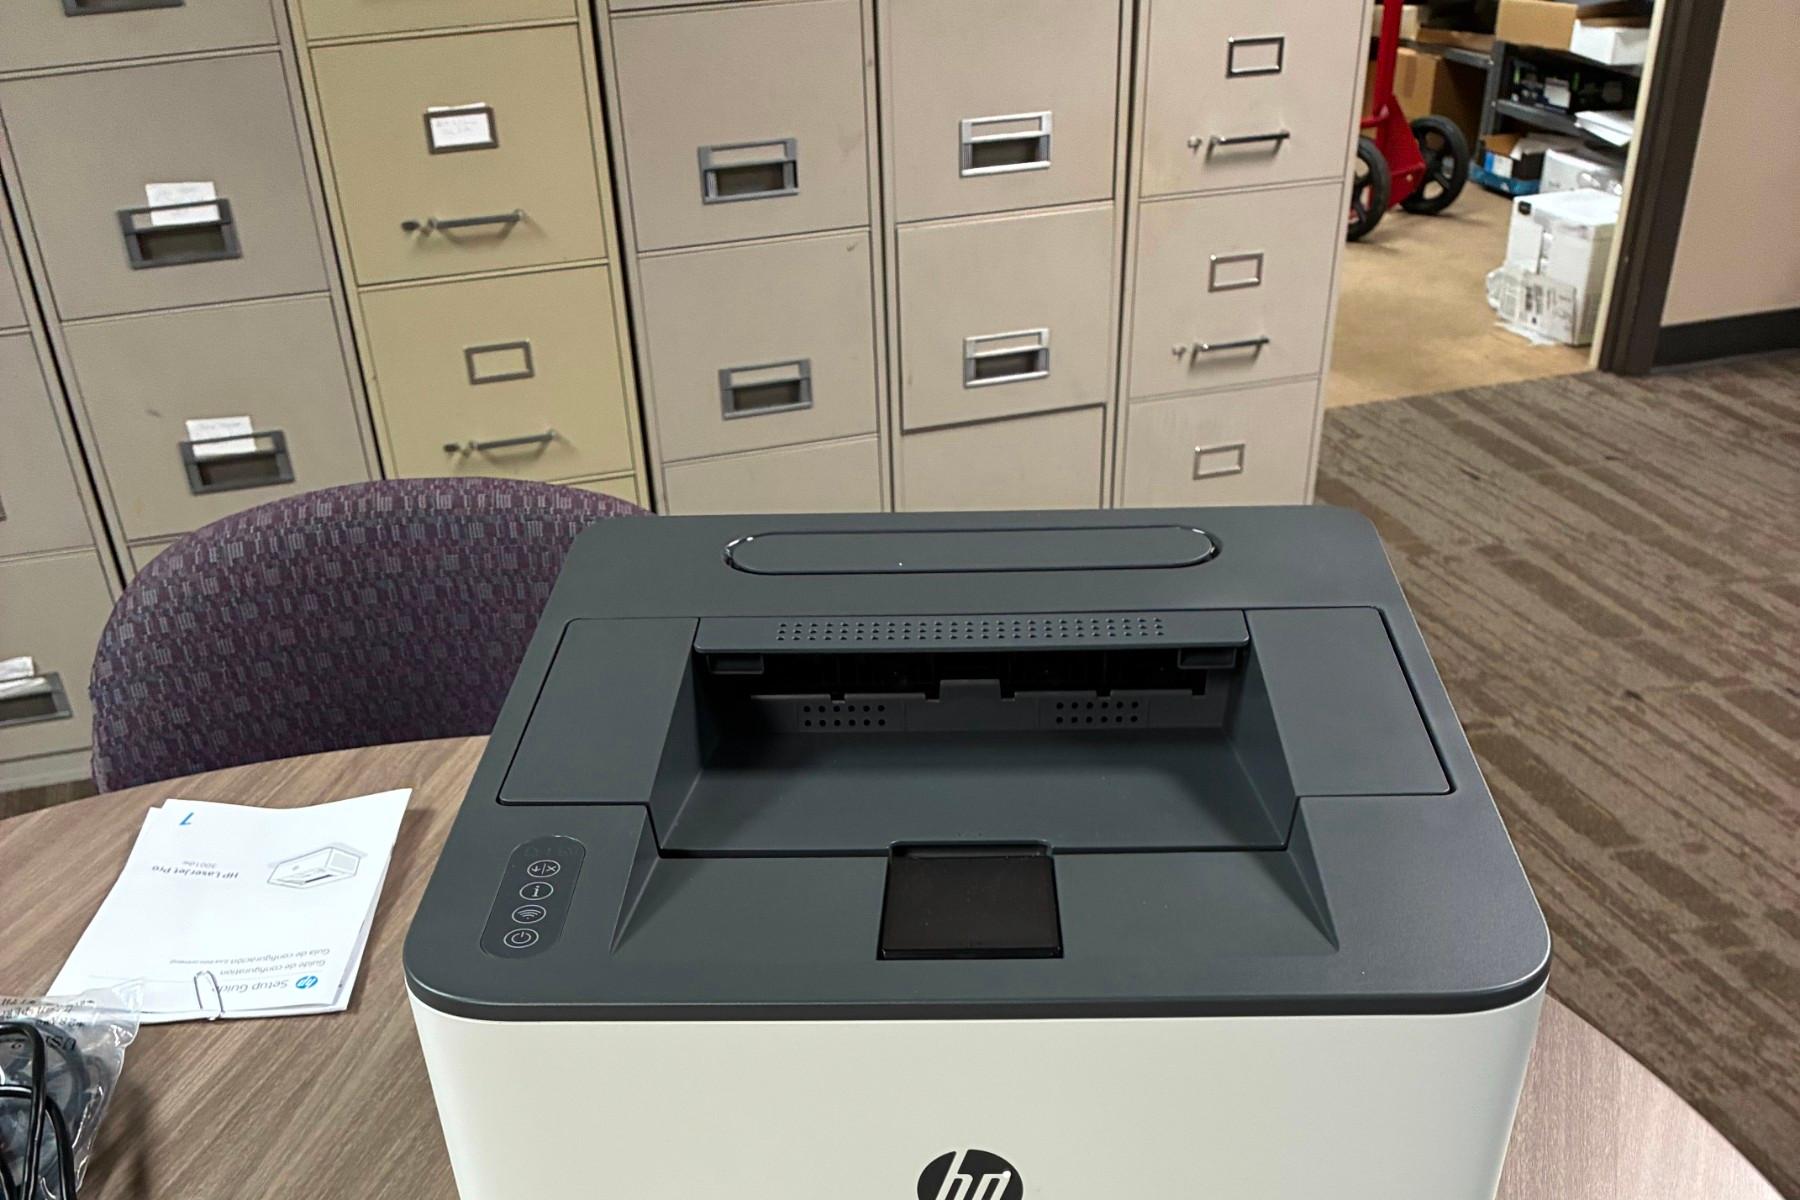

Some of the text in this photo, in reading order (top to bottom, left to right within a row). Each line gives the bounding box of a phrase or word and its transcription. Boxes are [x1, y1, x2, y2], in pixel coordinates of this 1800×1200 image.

[179, 812, 194, 826] 7
[152, 865, 172, 874] Pro
[173, 867, 221, 878] LaserJet
[252, 979, 289, 991] Setup
